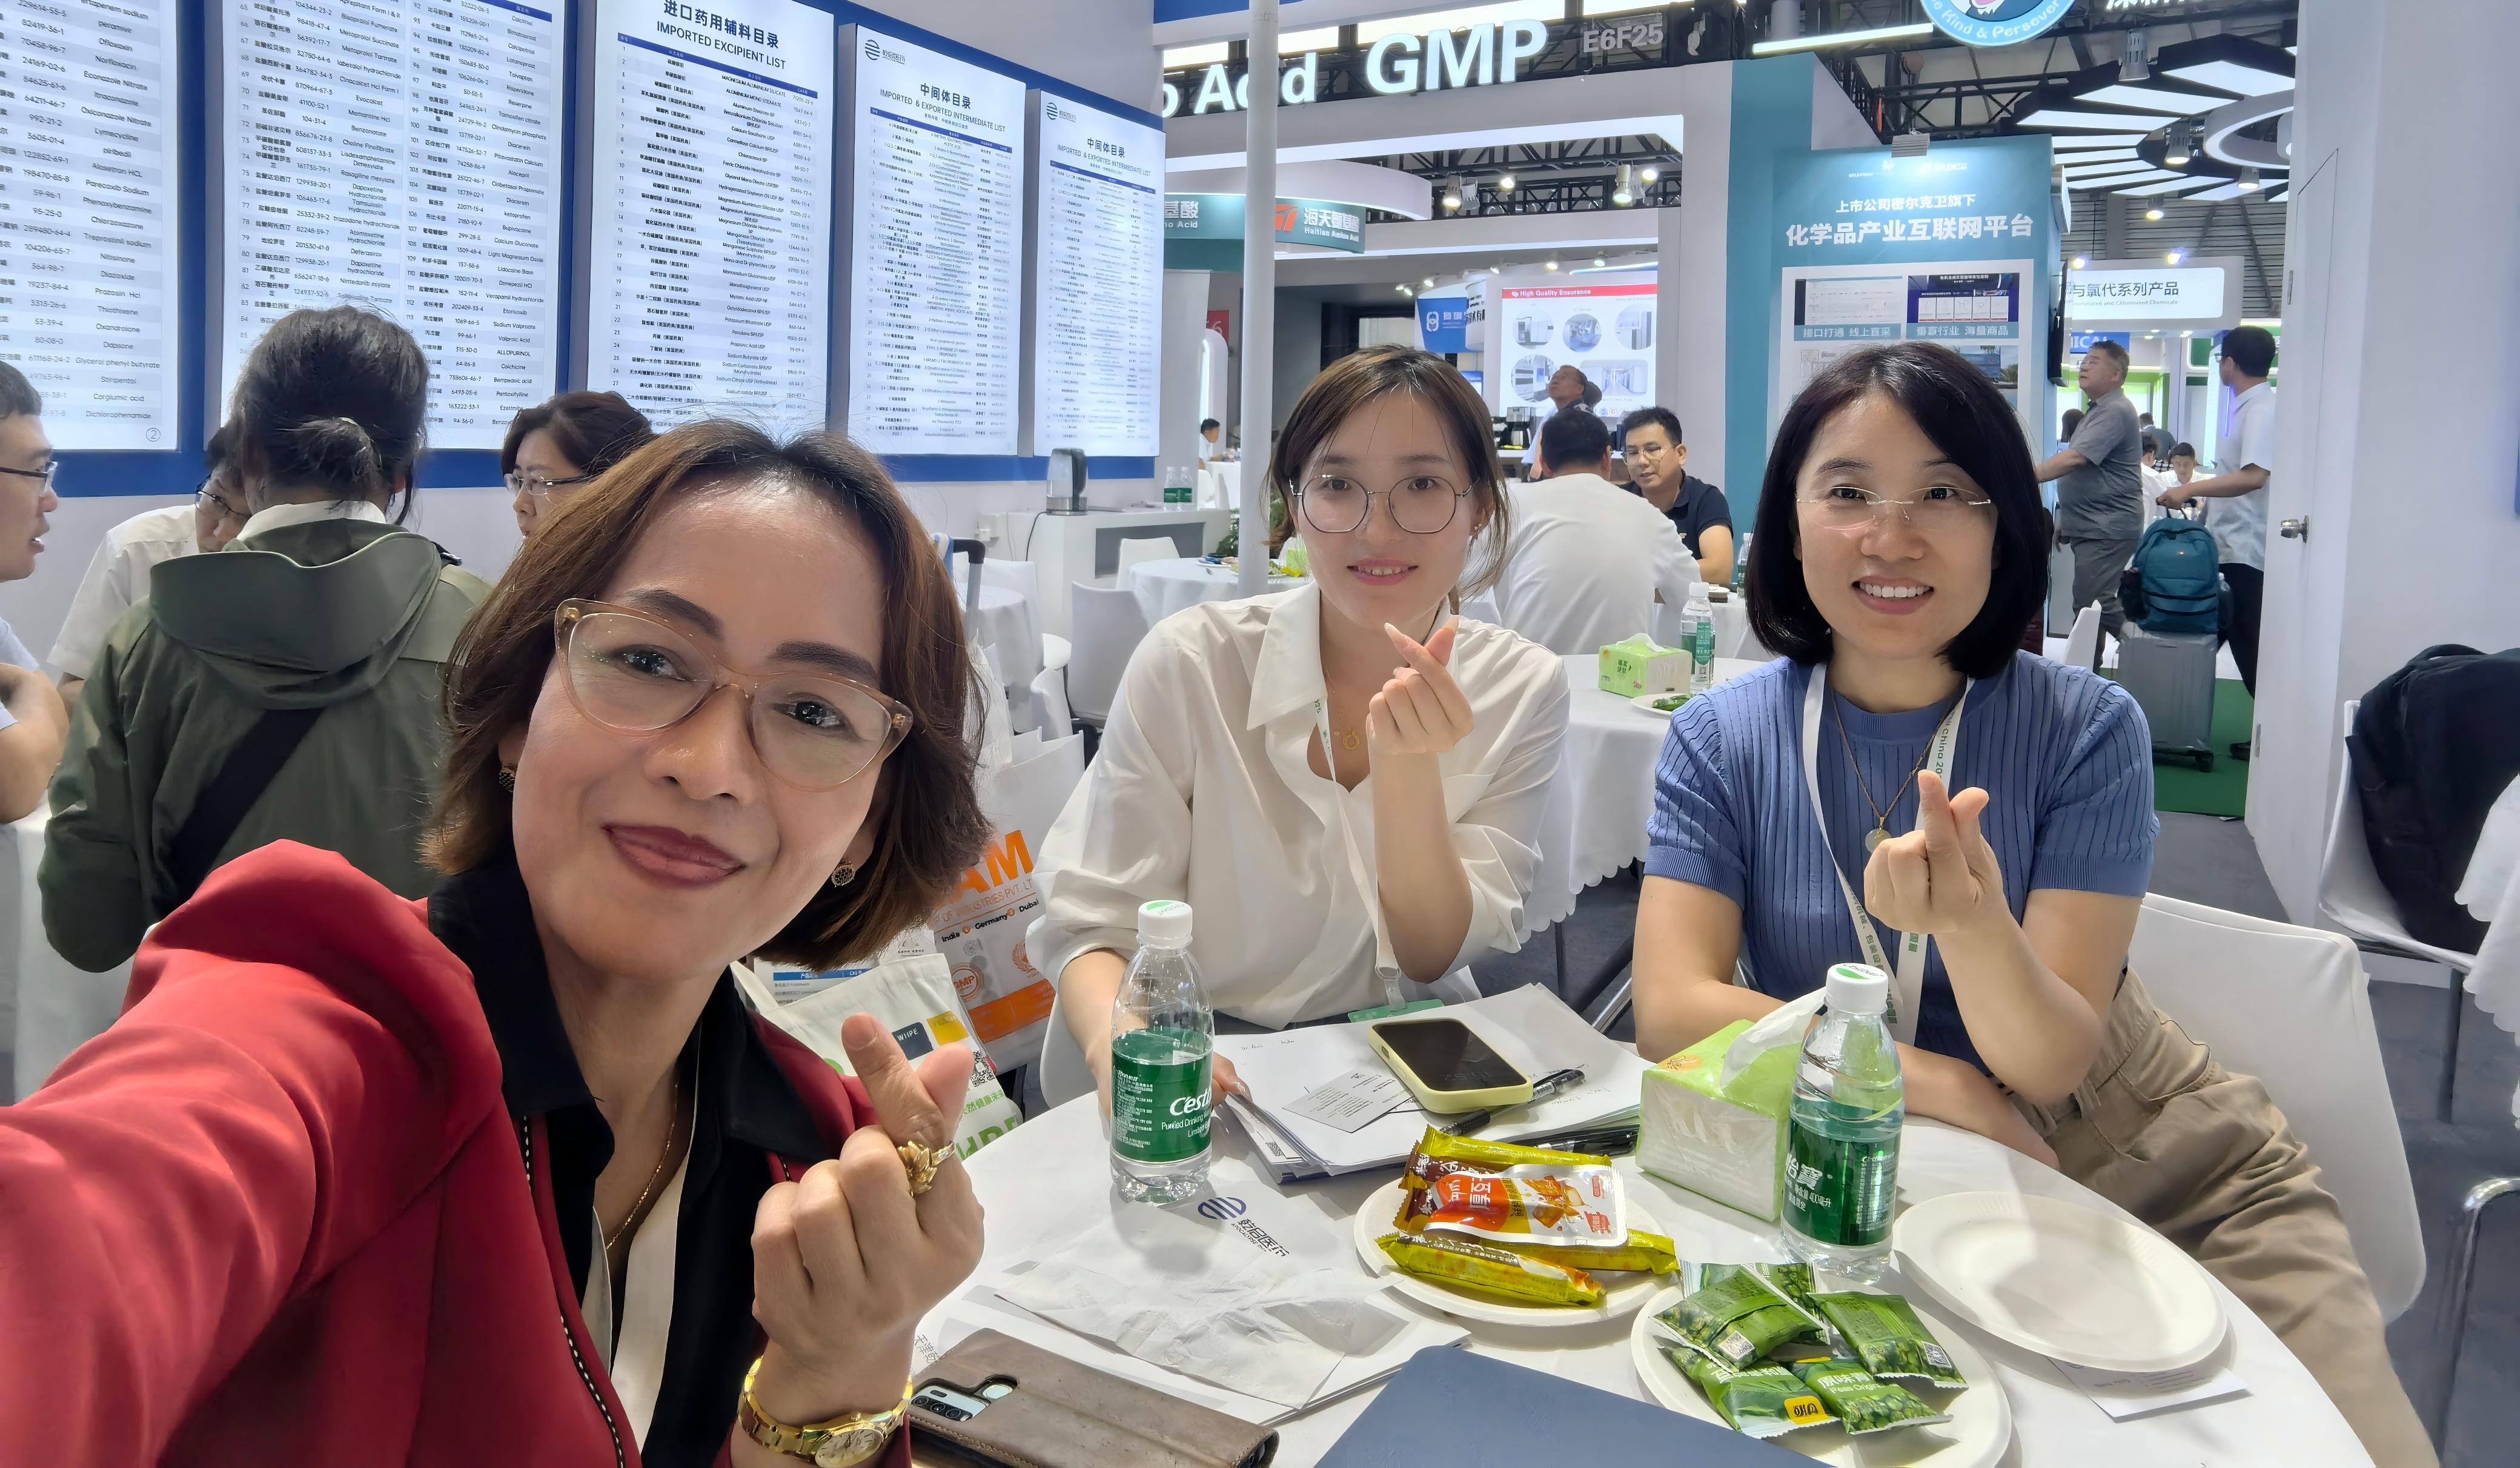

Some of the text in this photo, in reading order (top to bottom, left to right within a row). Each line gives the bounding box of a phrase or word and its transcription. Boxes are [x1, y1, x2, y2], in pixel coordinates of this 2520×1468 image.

[664, 0, 778, 48] 进口药用辅料目录
[1941, 9, 1973, 34] Kind
[1976, 27, 1988, 39] &
[657, 21, 786, 70] IMPORTED EXCIPIENT LIST
[1582, 23, 1665, 53] E6F25
[1367, 19, 1549, 95] GMP
[920, 83, 971, 110] 中间体目录
[880, 88, 913, 105] IMPORTED
[921, 102, 952, 117] EXPORTED
[953, 111, 993, 129] INTERMEDIATE
[994, 122, 1006, 132] LIST
[1057, 144, 1081, 156] IMPORTED
[1088, 153, 1111, 165] EXPORTED
[1112, 161, 1142, 174] INTERMEDIATE
[1142, 168, 1151, 177] LIST
[1087, 137, 1125, 158] 中间体目录
[1835, 194, 1977, 213] 上市公司密尔克卫旗下
[1303, 207, 1360, 233] 海天氨基酸
[1304, 226, 1330, 237] Haitian
[1785, 213, 2034, 247] 化学品产业互联网平台
[512, 293, 544, 303] hydrochloride
[1535, 288, 1558, 297] Quality
[1849, 327, 1891, 337] 线上直采
[103, 341, 134, 350] Dapsone
[76, 357, 105, 365] Glycerol
[974, 912, 1009, 930] Germany
[1019, 898, 1040, 913] Dubai
[1161, 1114, 1203, 1131] Purified Drinking
